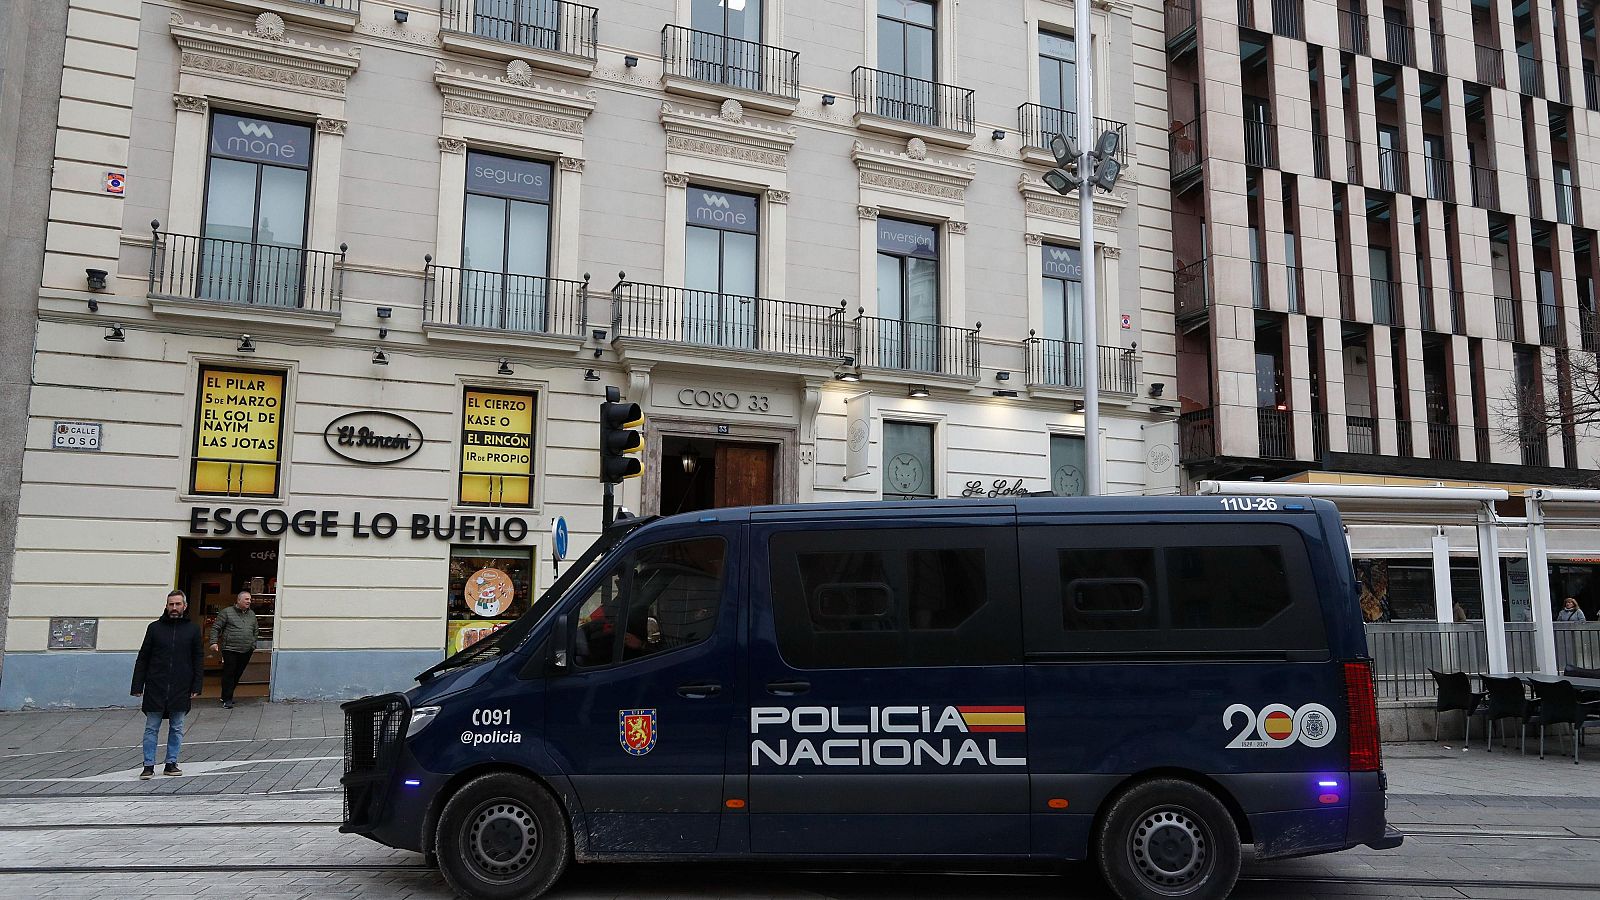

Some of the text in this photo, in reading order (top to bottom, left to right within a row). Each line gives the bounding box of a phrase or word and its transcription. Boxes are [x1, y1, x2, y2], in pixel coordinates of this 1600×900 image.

[474, 166, 543, 186] seguros
[207, 377, 266, 391] EL PILAR
[226, 394, 277, 408] MARZO
[468, 397, 526, 411] EL CIERZO
[678, 387, 770, 412] COSO 33
[204, 409, 275, 423] EL GOL DE
[467, 414, 510, 427] KASE O
[70, 427, 96, 435] CALLE
[203, 420, 249, 433] NAYIM
[57, 436, 97, 446] COSO
[337, 425, 355, 446] El
[467, 433, 529, 447] EL RINCÓN
[202, 436, 275, 450] LAS JOTAS
[466, 451, 477, 461] IR
[486, 452, 529, 464] PROPIO
[961, 480, 987, 498] La
[1220, 497, 1278, 511] 11U-26
[189, 506, 528, 542] ESCOGE LO BUENO
[481, 708, 511, 726] 091
[460, 730, 522, 747] @policia
[751, 738, 1027, 766] NACIONAL
